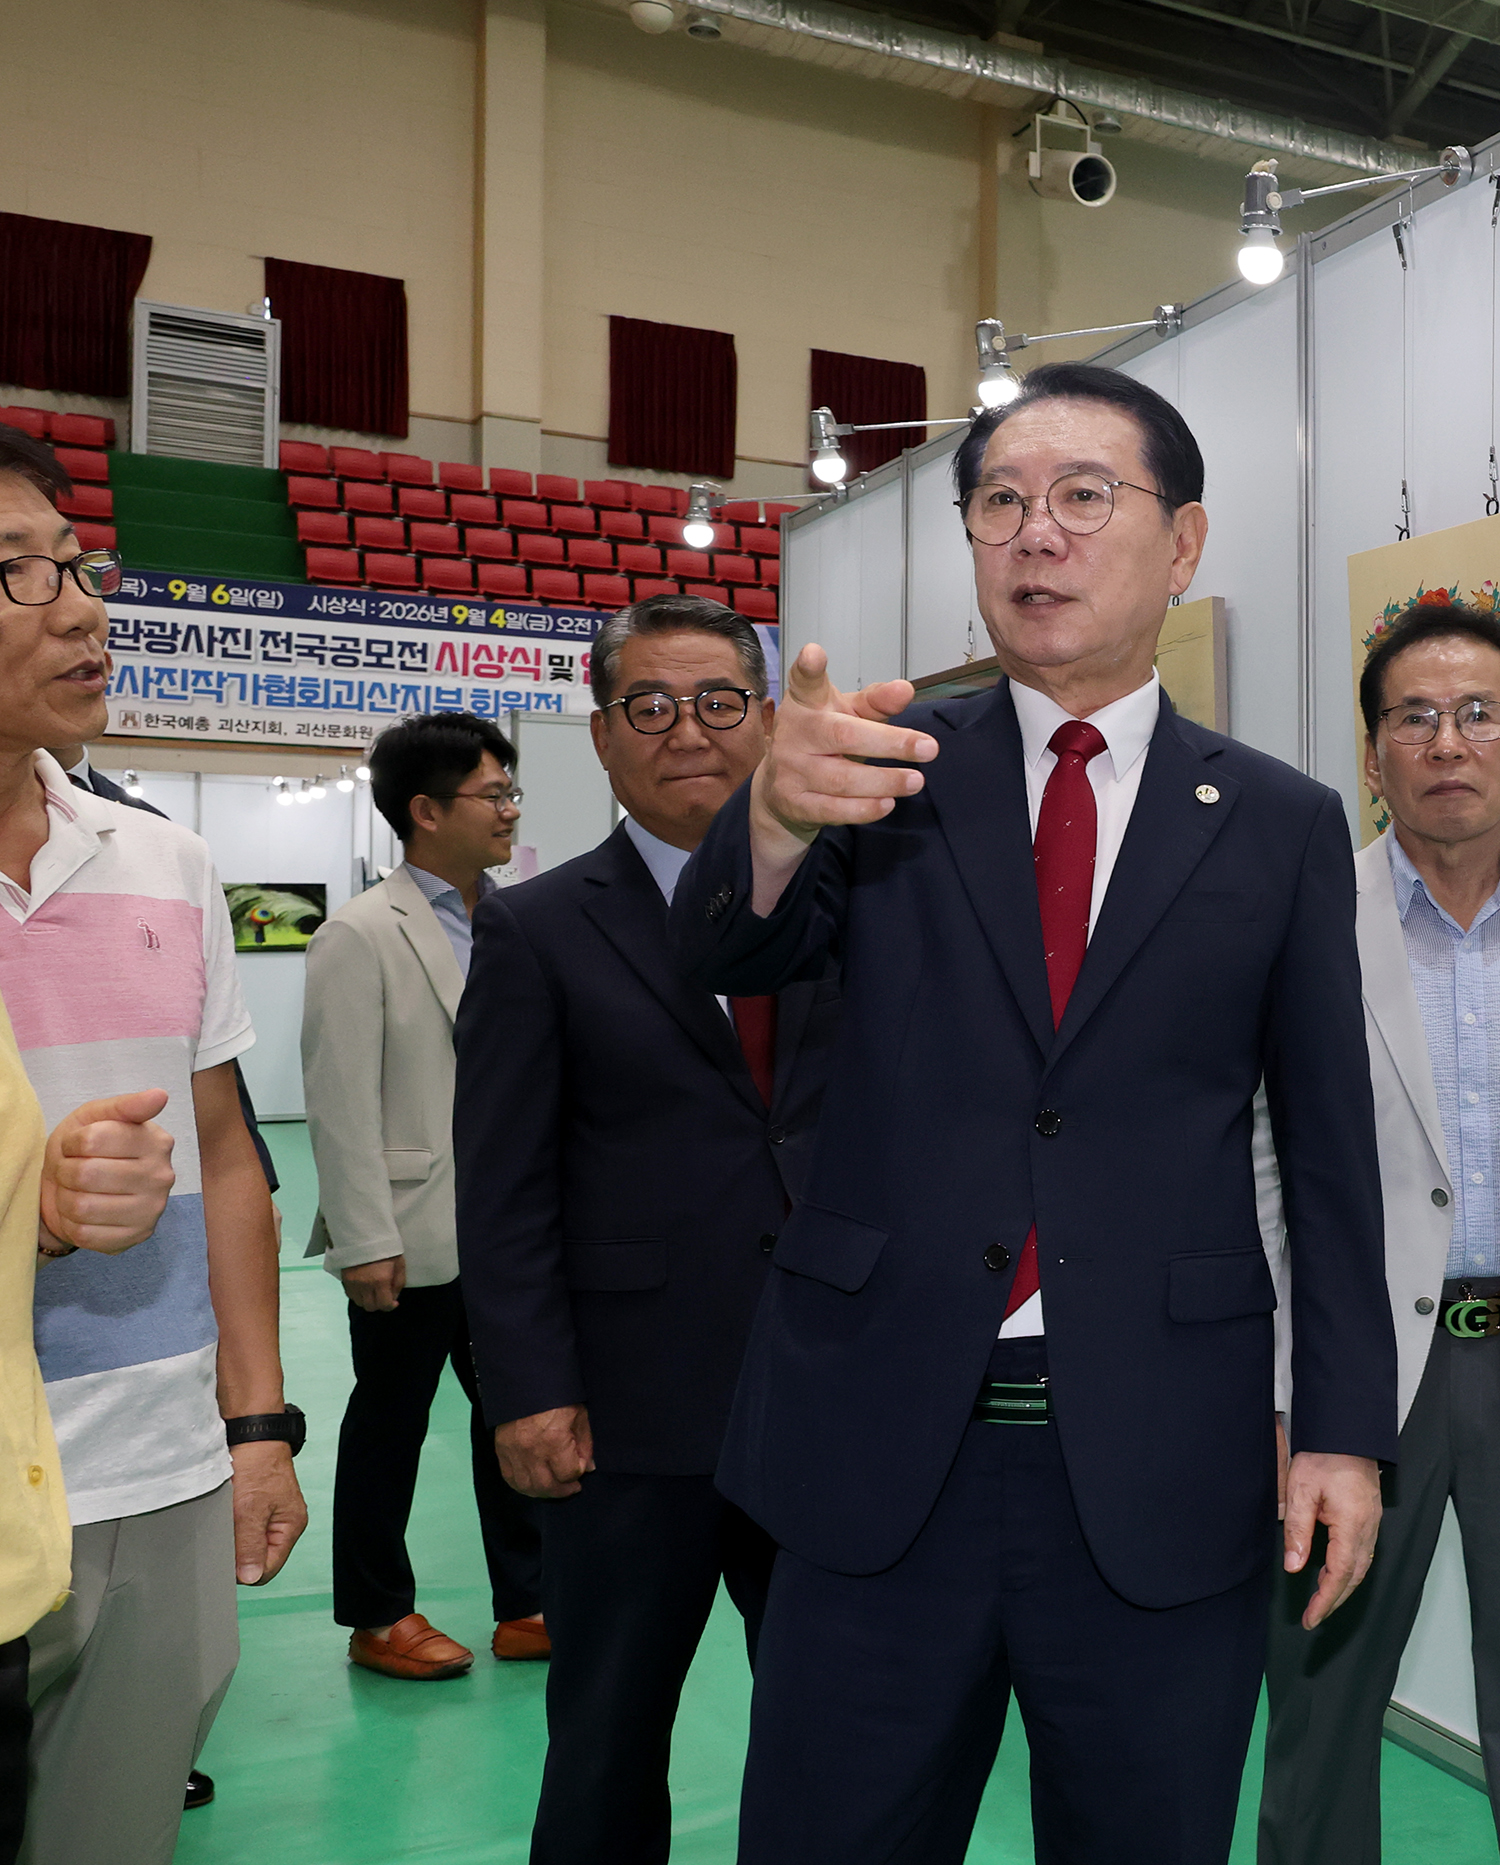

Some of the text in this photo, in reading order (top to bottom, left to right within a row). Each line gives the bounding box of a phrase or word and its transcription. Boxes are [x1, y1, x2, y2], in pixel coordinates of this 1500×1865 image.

[167, 578, 207, 603] 9월
[211, 584, 284, 609] 6일(일)
[307, 594, 367, 616] 시상식
[378, 600, 449, 624] 2026년
[451, 604, 487, 627] 9월
[489, 608, 554, 632] 4일(금)
[555, 616, 592, 636] 오전
[258, 628, 428, 672] 전국공모전
[434, 641, 542, 682] 시상식
[548, 653, 574, 682] 및
[104, 665, 465, 715] 사진작가협회괴산지부
[144, 713, 211, 731] 한국예총
[295, 722, 374, 741] 괴산문화원
